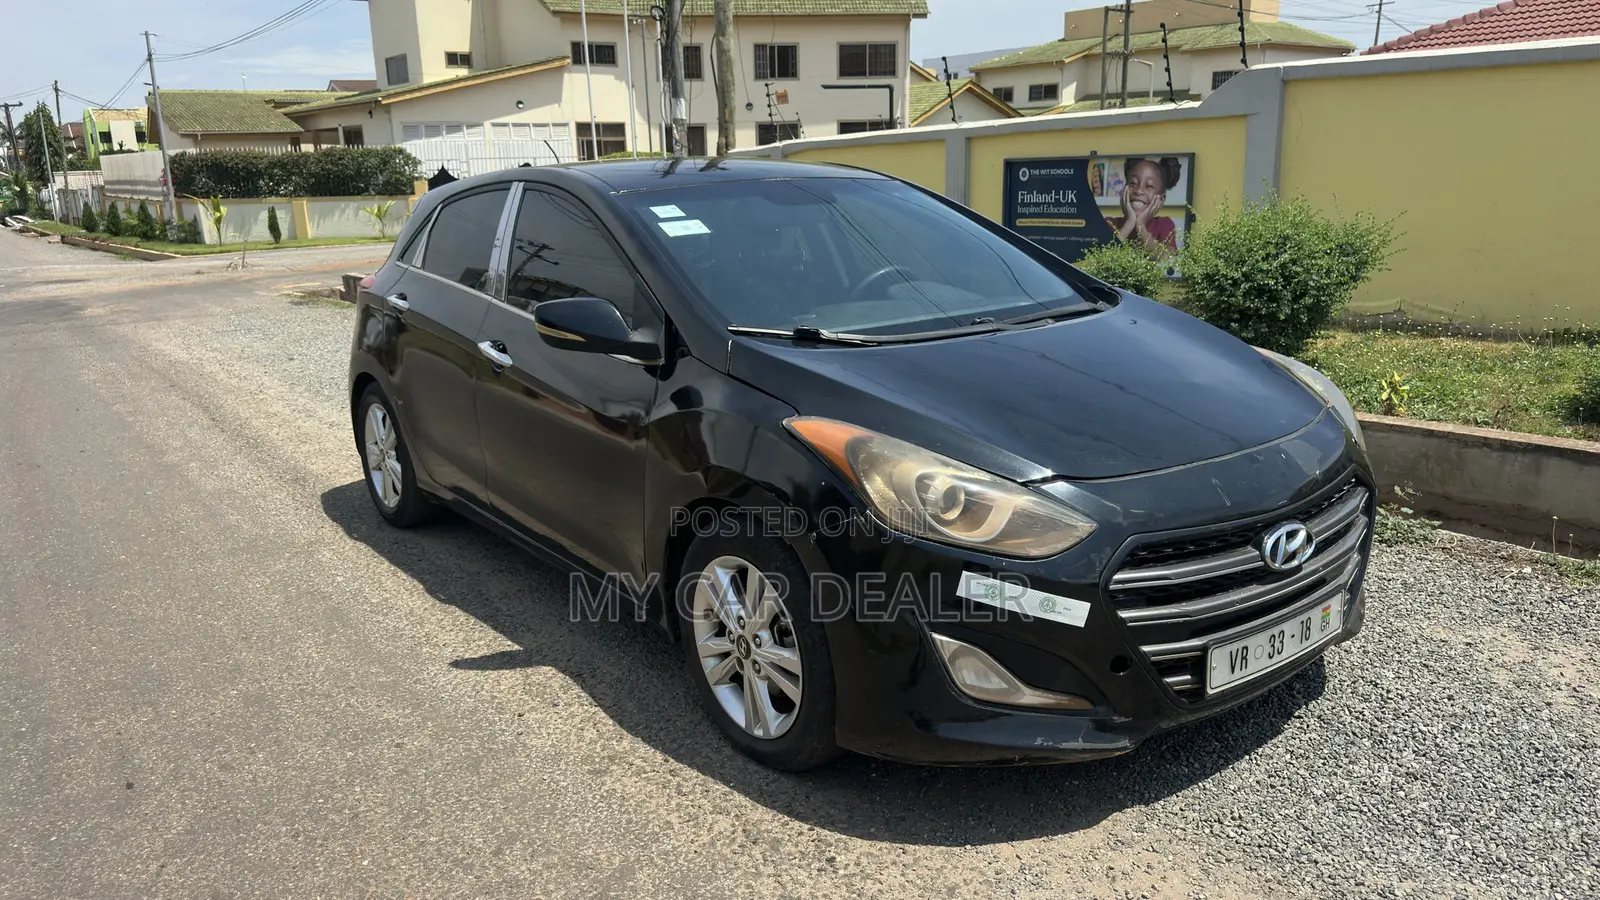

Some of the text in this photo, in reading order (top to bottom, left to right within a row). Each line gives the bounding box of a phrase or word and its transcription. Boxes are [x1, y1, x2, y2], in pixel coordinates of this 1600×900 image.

[1018, 190, 1077, 203] Finland-UK
[1017, 204, 1077, 215] Inspired Education
[1320, 619, 1330, 632] GH
[1229, 645, 1249, 674] VR
[1268, 630, 1285, 659] 33
[1300, 616, 1312, 644] 18
